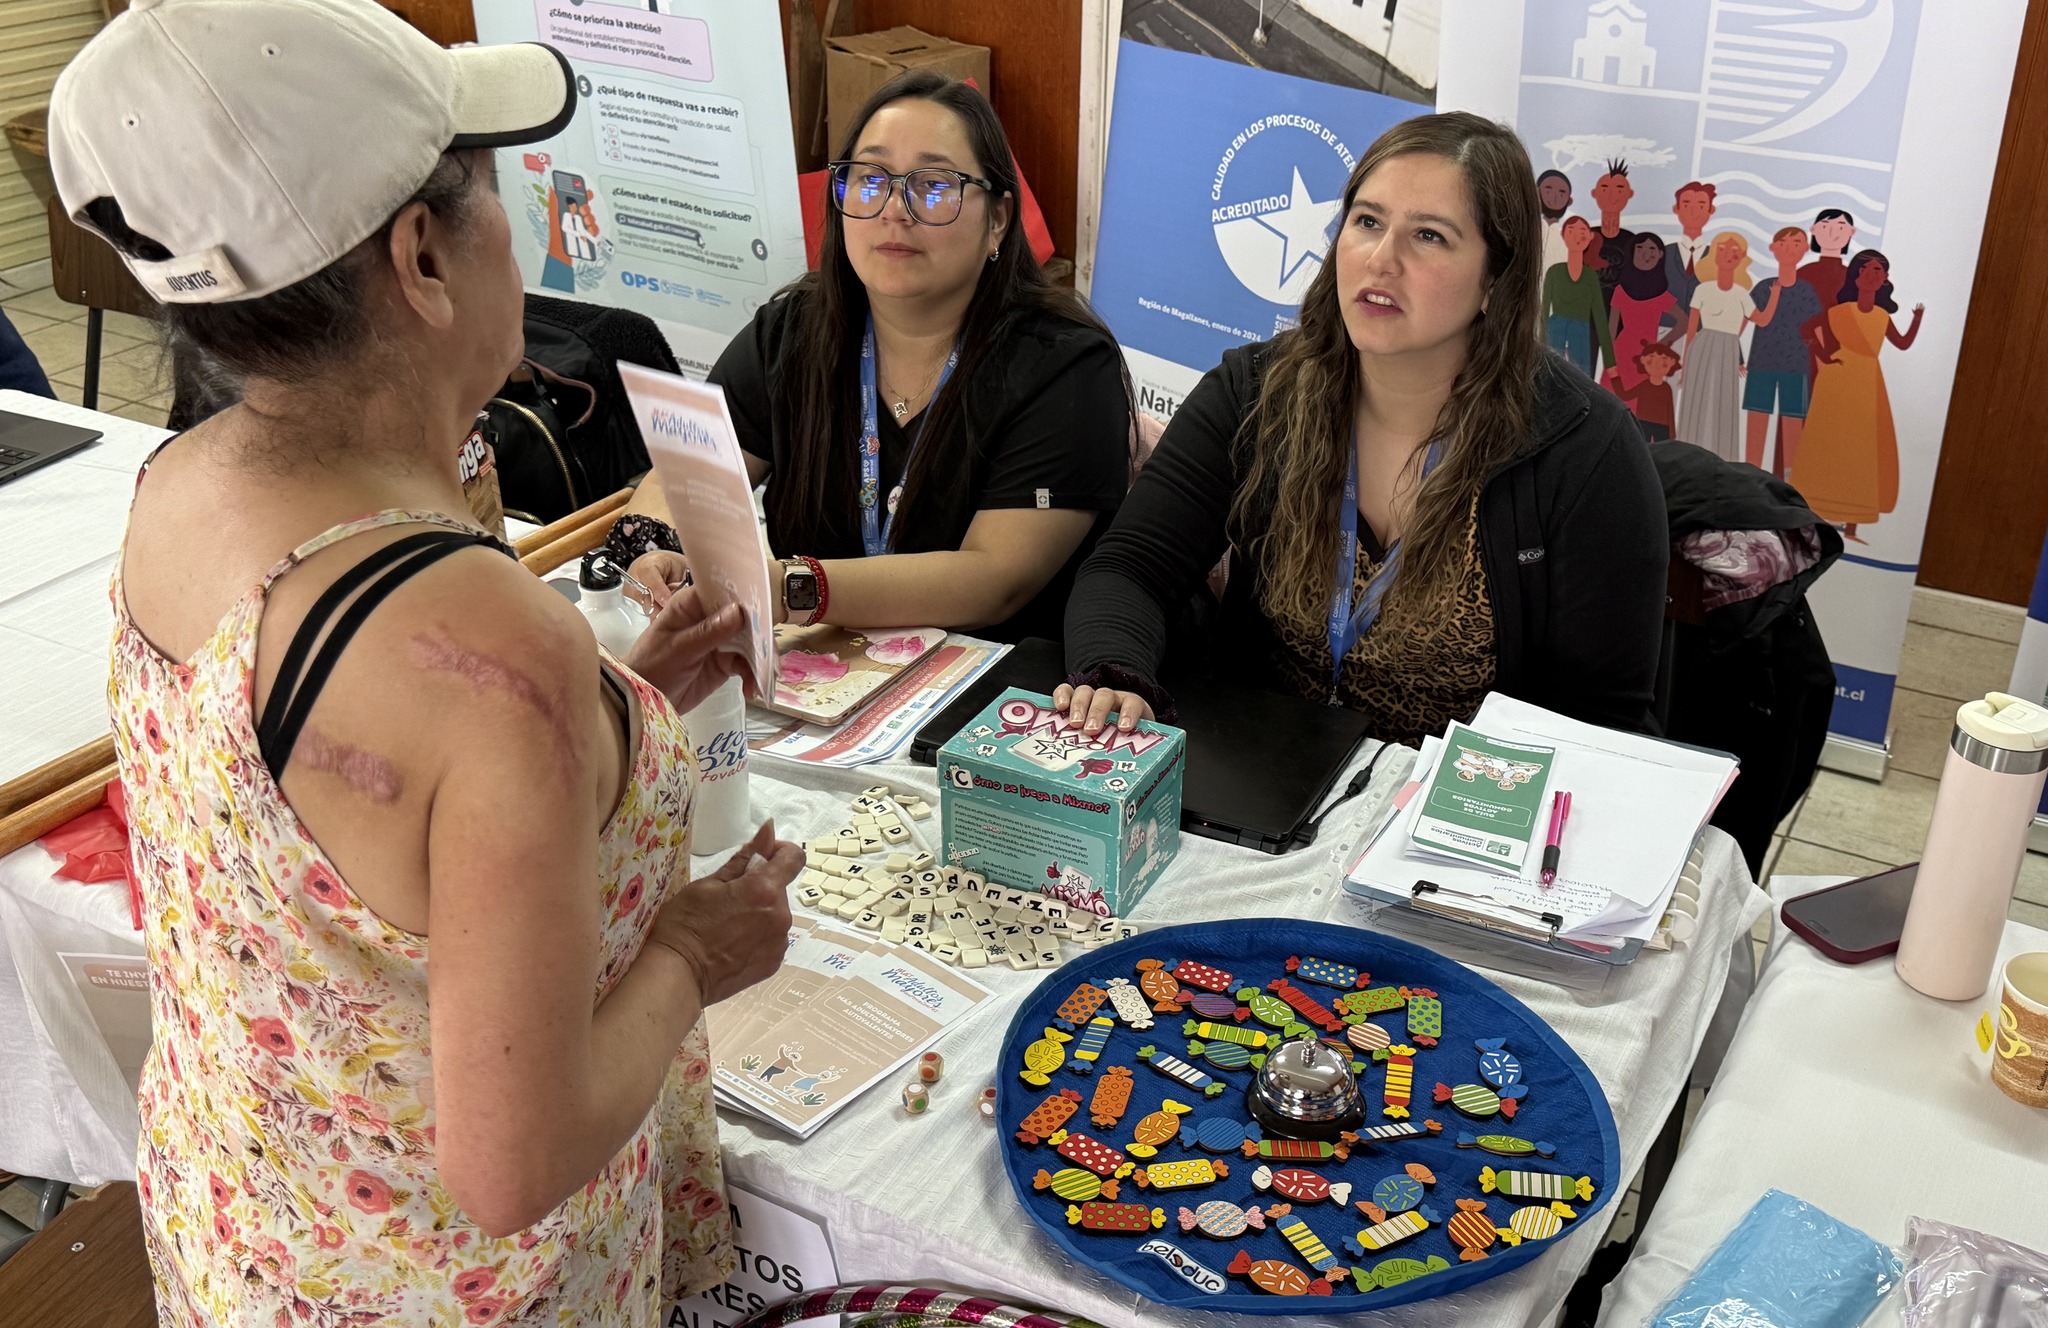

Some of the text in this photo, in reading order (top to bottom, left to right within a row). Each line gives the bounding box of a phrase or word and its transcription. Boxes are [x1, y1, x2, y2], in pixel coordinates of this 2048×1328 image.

[573, 14, 582, 22] se
[584, 14, 615, 27] prioriza
[616, 18, 624, 28] la
[625, 20, 662, 35] atención?
[580, 80, 589, 94] 5
[597, 85, 617, 96] ¿Qué
[618, 88, 635, 99] tipo
[636, 91, 646, 101] de
[647, 94, 684, 109] respuesta
[685, 102, 699, 113] vas
[707, 105, 739, 119] recibir?
[1211, 147, 1235, 201] CALIDAD
[1232, 132, 1247, 151] EN
[1245, 119, 1265, 139] LOS
[1266, 114, 1322, 135] PROCESOS
[1320, 127, 1338, 147] DE
[612, 187, 637, 200] ¿Cómo
[637, 192, 659, 204] saber
[660, 197, 668, 205] el
[669, 198, 693, 211] estado
[693, 203, 702, 212] de
[703, 207, 712, 216] tu
[712, 208, 752, 223] solicitud?
[1211, 193, 1289, 223] ACREDITADO
[756, 244, 764, 256] 6
[166, 269, 218, 293] JUVENTUS
[620, 271, 660, 293] OPS
[1138, 296, 1262, 343] Región de Magallanes, enero de 2024
[1003, 782, 1019, 794] se
[1020, 785, 1051, 803] juega
[1051, 793, 1061, 804] a
[1062, 793, 1111, 815] Mixmo?
[1452, 794, 1513, 813] COMUNITARIOS
[1463, 802, 1498, 814] ACTIVOS
[1474, 809, 1495, 818] GUÍA
[840, 829, 853, 837] C
[889, 827, 901, 835] D
[1431, 827, 1483, 846] Comunitarios
[1452, 837, 1482, 848] Activos
[848, 864, 863, 874] H
[891, 891, 905, 899] A
[986, 889, 1001, 900] E
[1007, 895, 1022, 906] Y
[950, 911, 965, 920] S
[1049, 908, 1062, 918] E
[975, 918, 991, 928] E
[909, 926, 924, 937] G
[91, 976, 108, 985] EN
[106, 969, 150, 980] TE INV
[881, 968, 943, 1008] Mayores
[904, 977, 944, 1002] Adultos
[836, 995, 915, 1043] MÁS ADULTOS MAYORES
[862, 1001, 901, 1027] PROGRAMA
[843, 1008, 895, 1040] AUTOVALENTES
